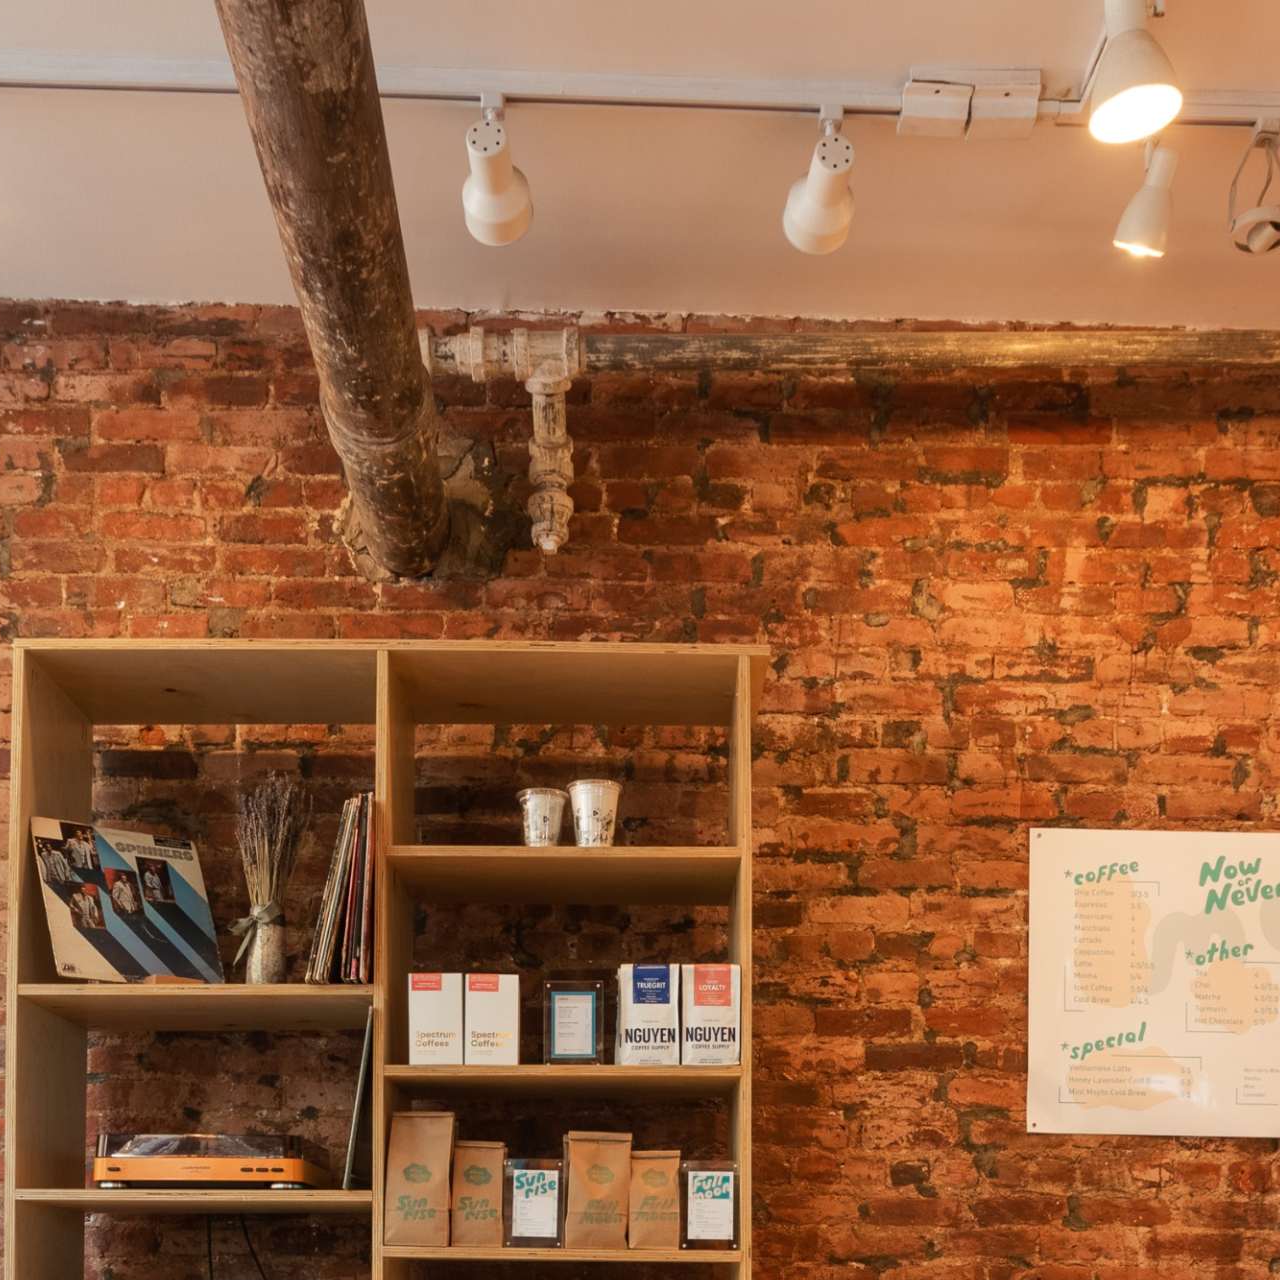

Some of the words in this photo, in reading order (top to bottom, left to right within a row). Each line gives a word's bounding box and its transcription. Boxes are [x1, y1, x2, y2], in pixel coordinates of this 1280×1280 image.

[1199, 855, 1261, 886] Now
[1238, 877, 1252, 887] or
[625, 1028, 675, 1043] NGUYEN
[686, 1027, 736, 1042] NGUYEN
[515, 1172, 545, 1191] Sun
[525, 1179, 556, 1199] rise
[396, 1196, 428, 1211] Sun
[457, 1197, 489, 1211] Sun
